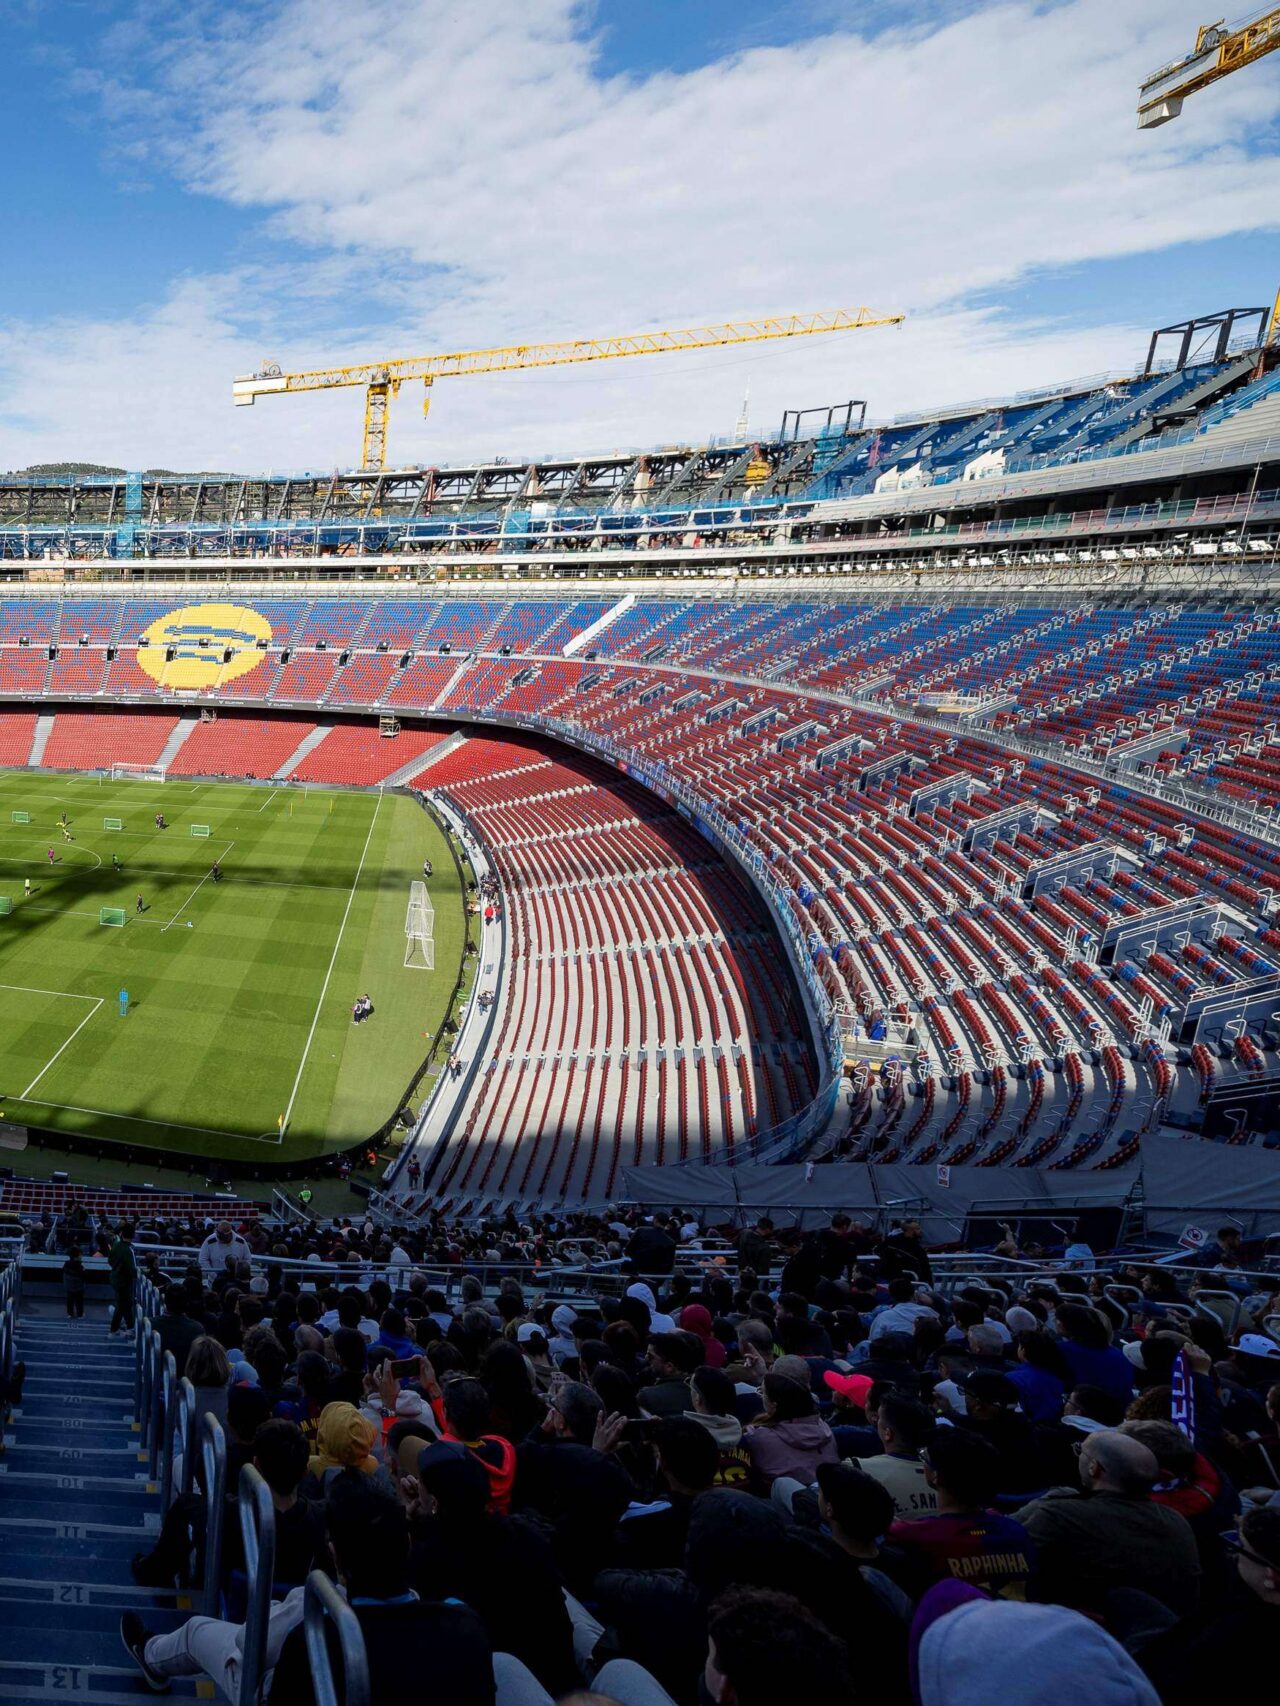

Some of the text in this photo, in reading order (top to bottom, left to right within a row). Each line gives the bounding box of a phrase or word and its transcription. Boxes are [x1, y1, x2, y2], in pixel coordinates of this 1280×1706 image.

[947, 1552, 1030, 1577] RAPHINHA
[60, 1586, 83, 1603] 12
[52, 1667, 81, 1689] 13
